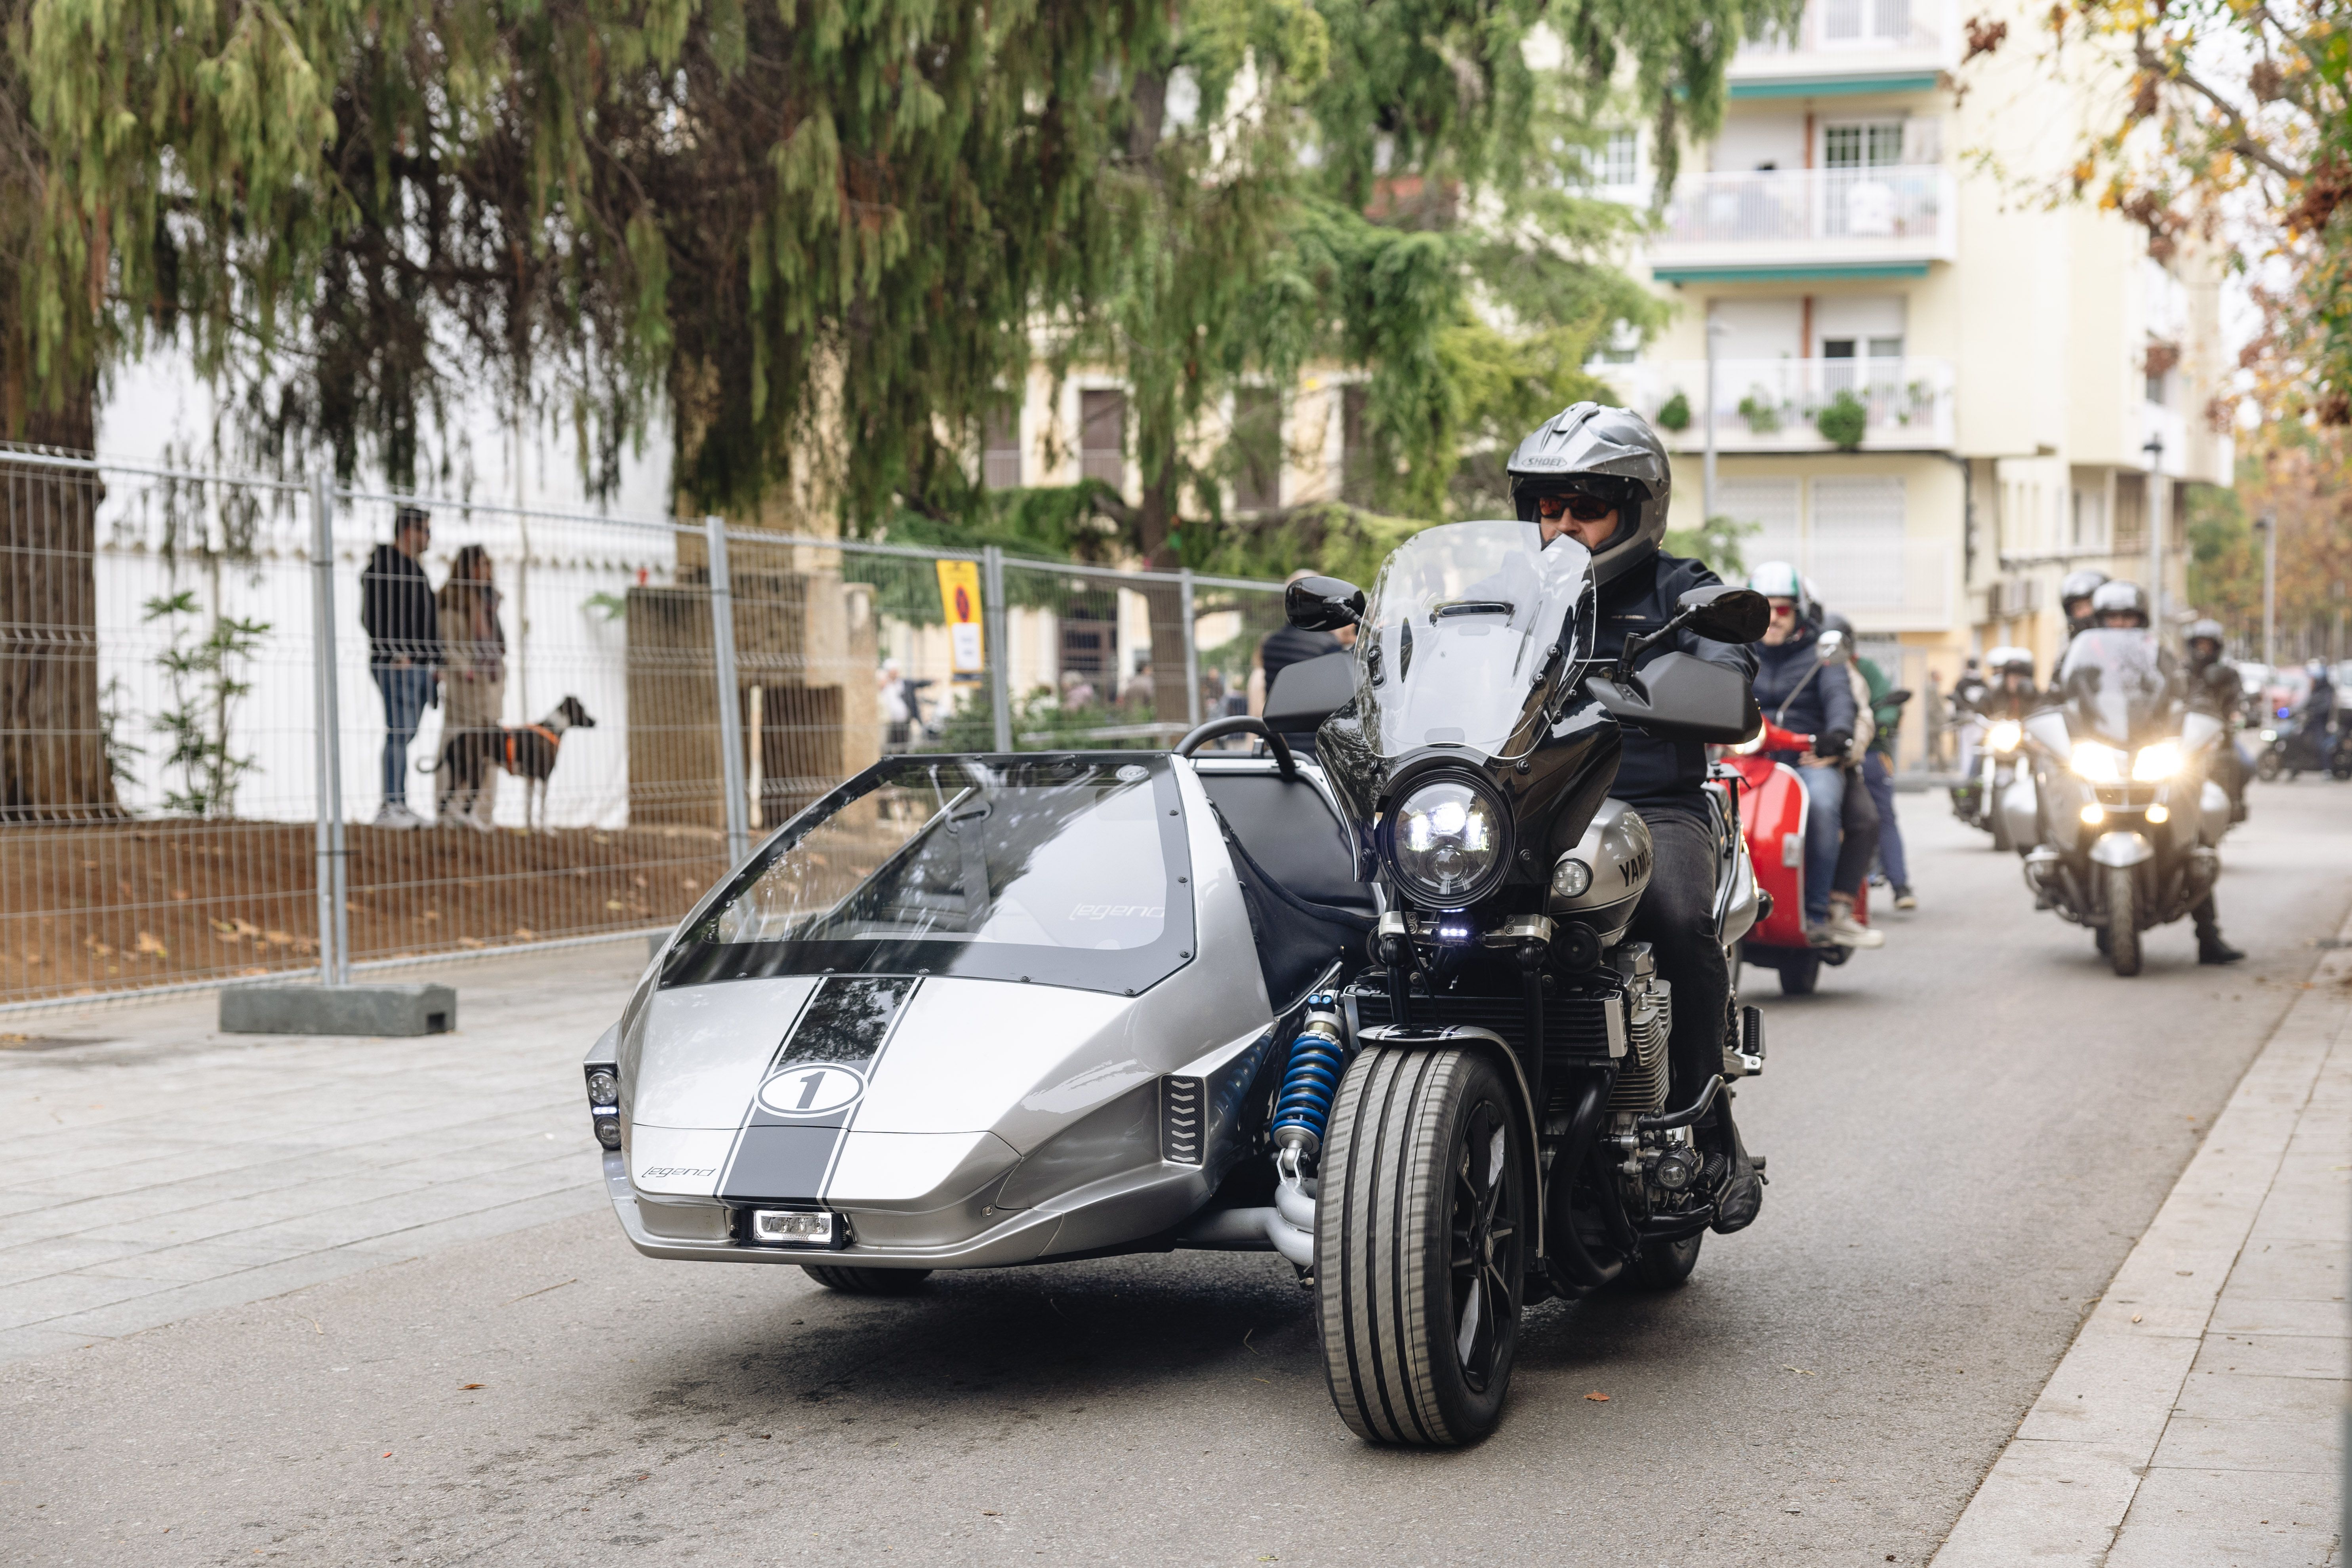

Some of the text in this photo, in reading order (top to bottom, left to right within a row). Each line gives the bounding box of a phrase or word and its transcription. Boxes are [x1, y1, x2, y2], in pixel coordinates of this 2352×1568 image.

[1527, 457, 1561, 466] SHOEI
[796, 1071, 826, 1109] 1
[641, 1166, 717, 1177] legend
